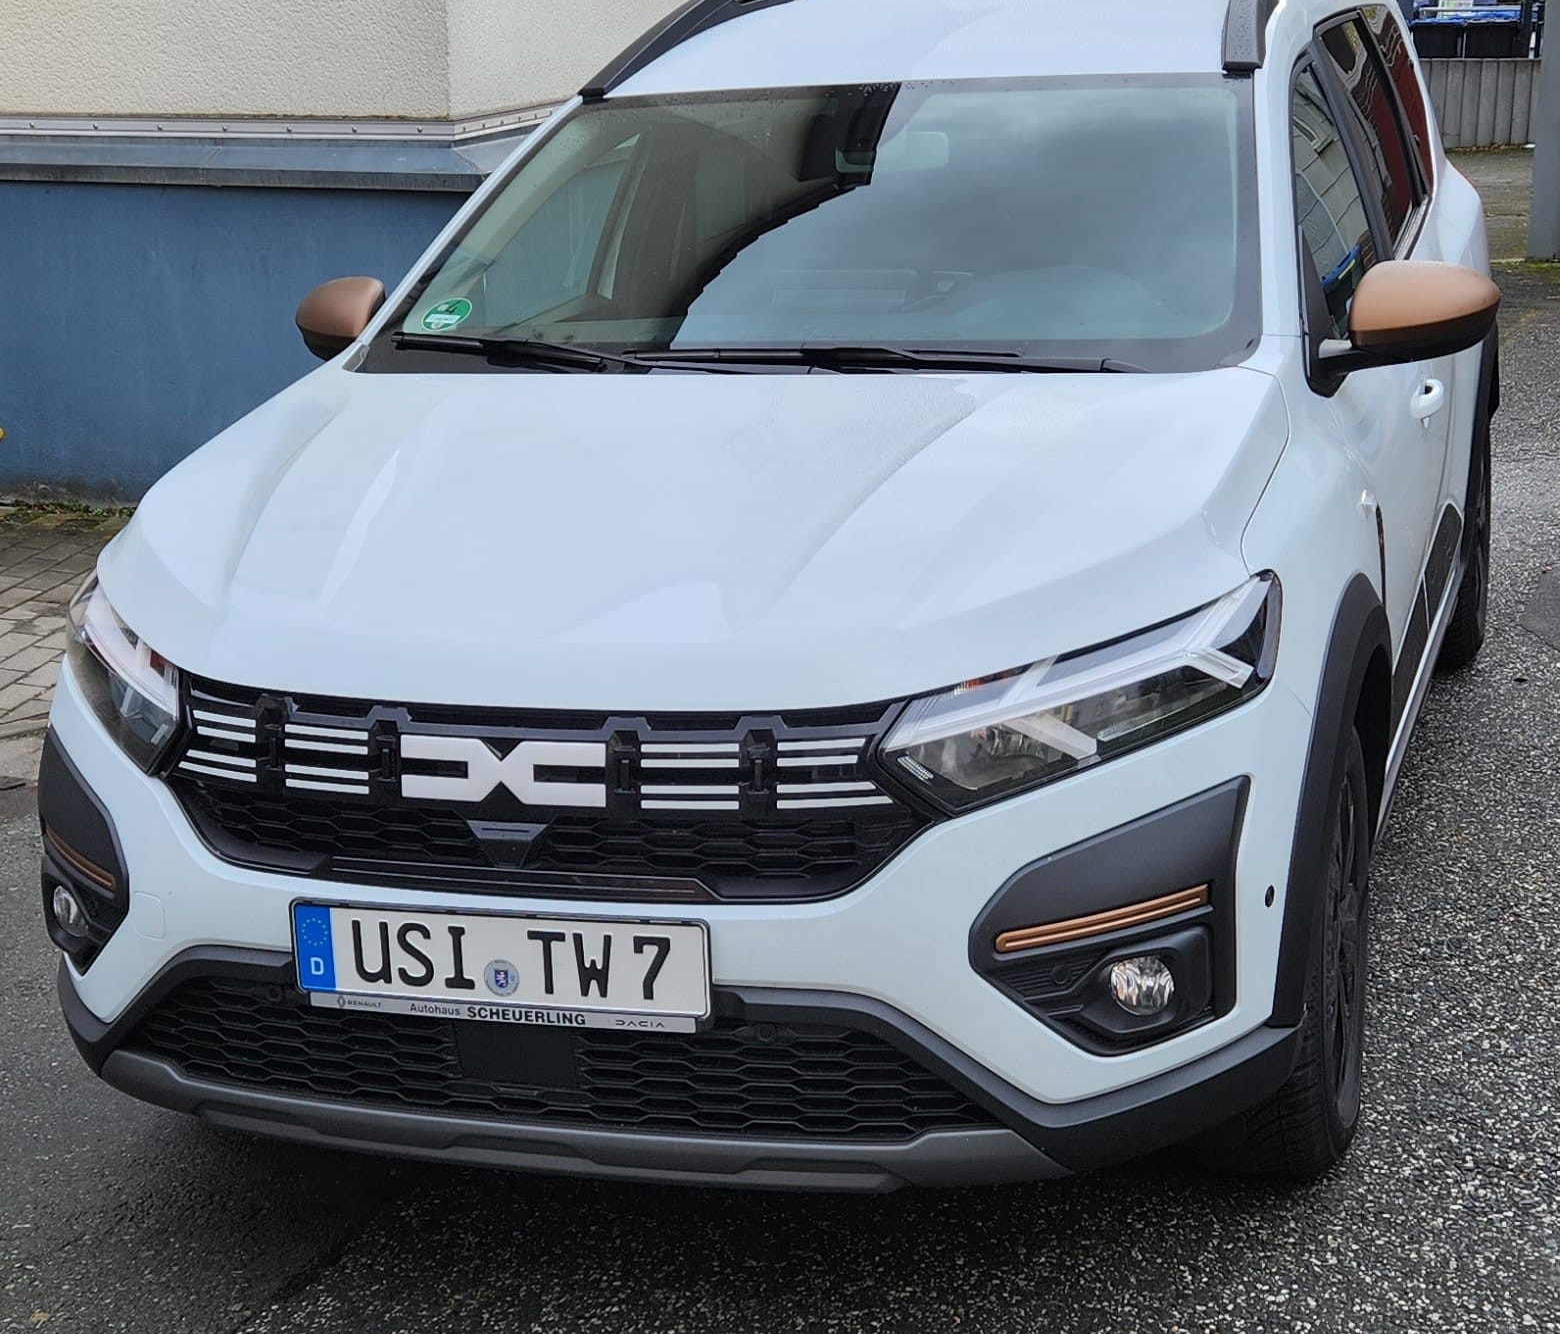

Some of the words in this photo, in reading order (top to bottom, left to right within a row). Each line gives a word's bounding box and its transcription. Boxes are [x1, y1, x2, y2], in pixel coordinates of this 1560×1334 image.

[310, 956, 325, 976] D
[351, 918, 476, 991] USI
[527, 929, 612, 999] TW
[633, 935, 671, 1001] 7
[347, 1000, 382, 1009] RENAULT
[410, 1003, 461, 1016] Autohaus
[467, 1006, 586, 1026] SCHEUERLING
[615, 1019, 665, 1028] DACIA
